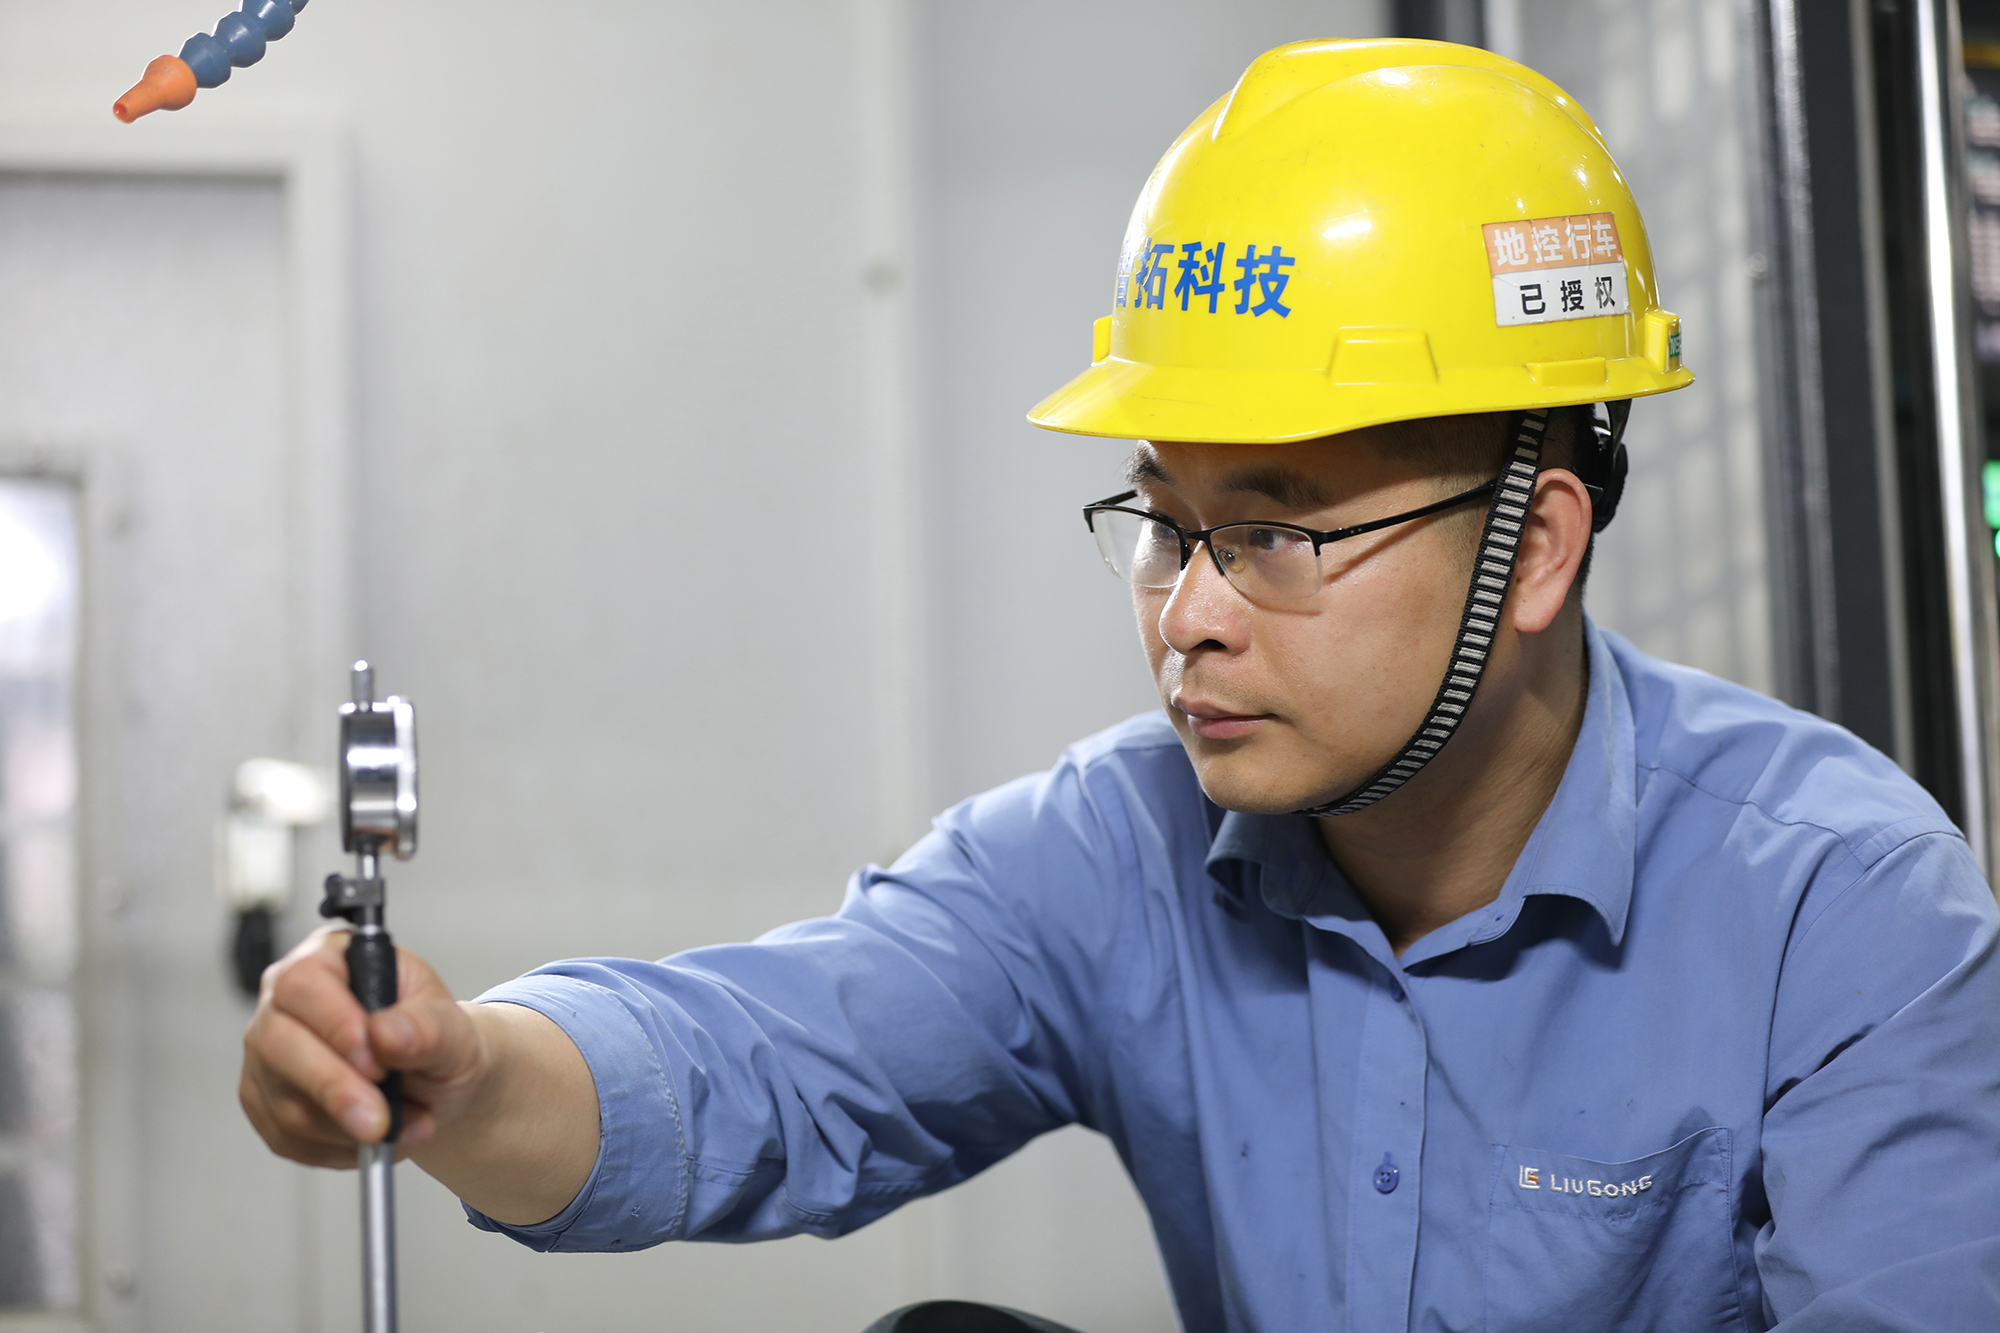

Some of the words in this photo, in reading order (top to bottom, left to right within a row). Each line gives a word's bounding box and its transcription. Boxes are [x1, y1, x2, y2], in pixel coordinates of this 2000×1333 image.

[1493, 220, 1618, 267] 地控行车
[1519, 276, 1616, 316] 已授权
[1550, 1174, 1653, 1198] LIUGONG
